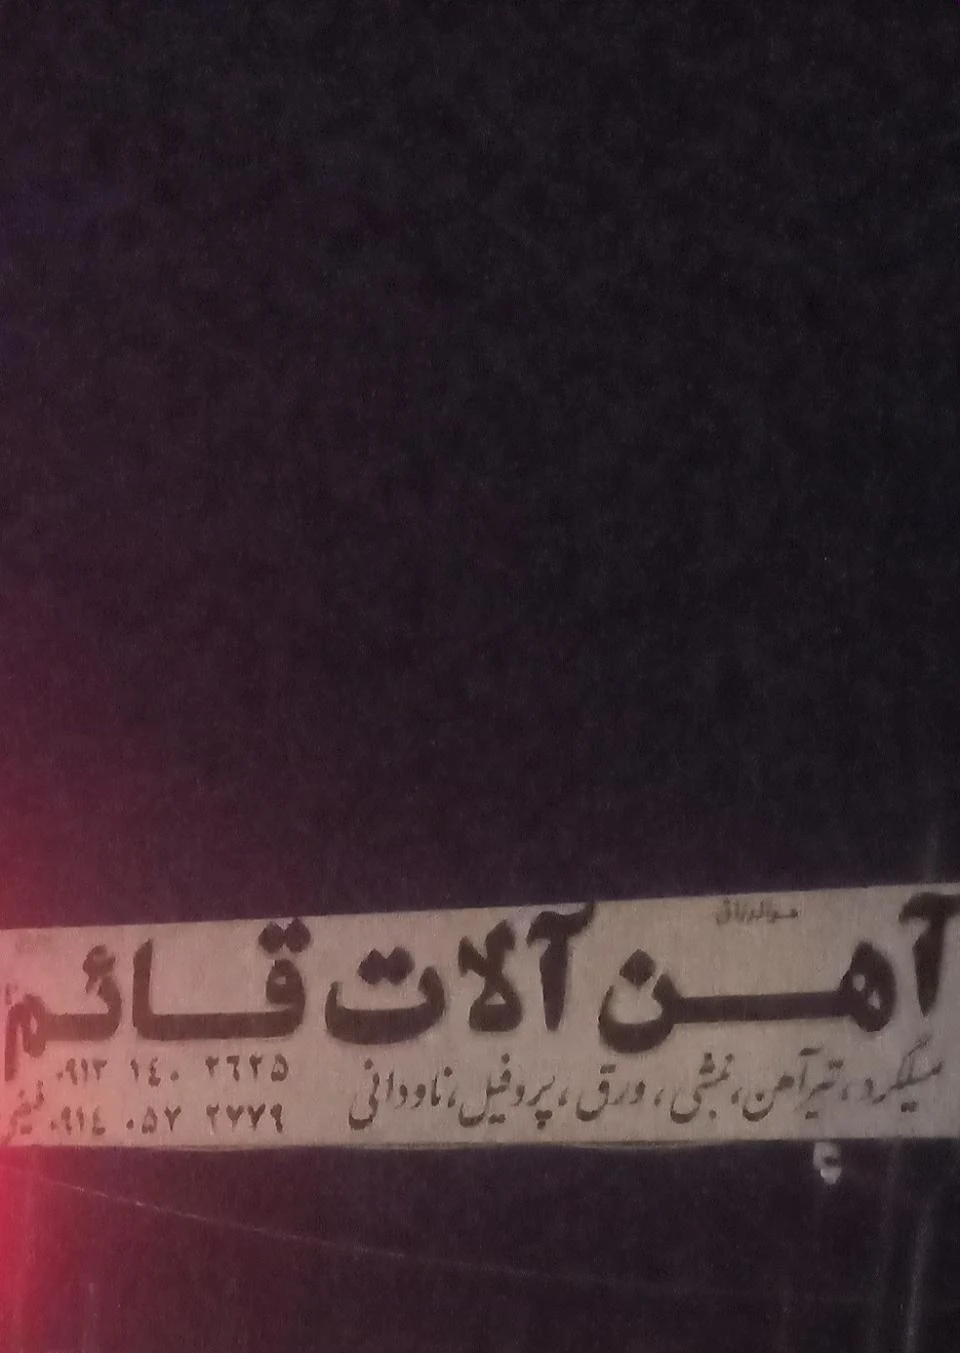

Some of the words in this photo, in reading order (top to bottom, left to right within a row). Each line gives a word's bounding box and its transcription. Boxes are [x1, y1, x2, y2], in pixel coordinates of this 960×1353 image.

[4, 917, 307, 1082] قائم
[325, 902, 594, 1046] آلات
[599, 891, 960, 1054] آهن
